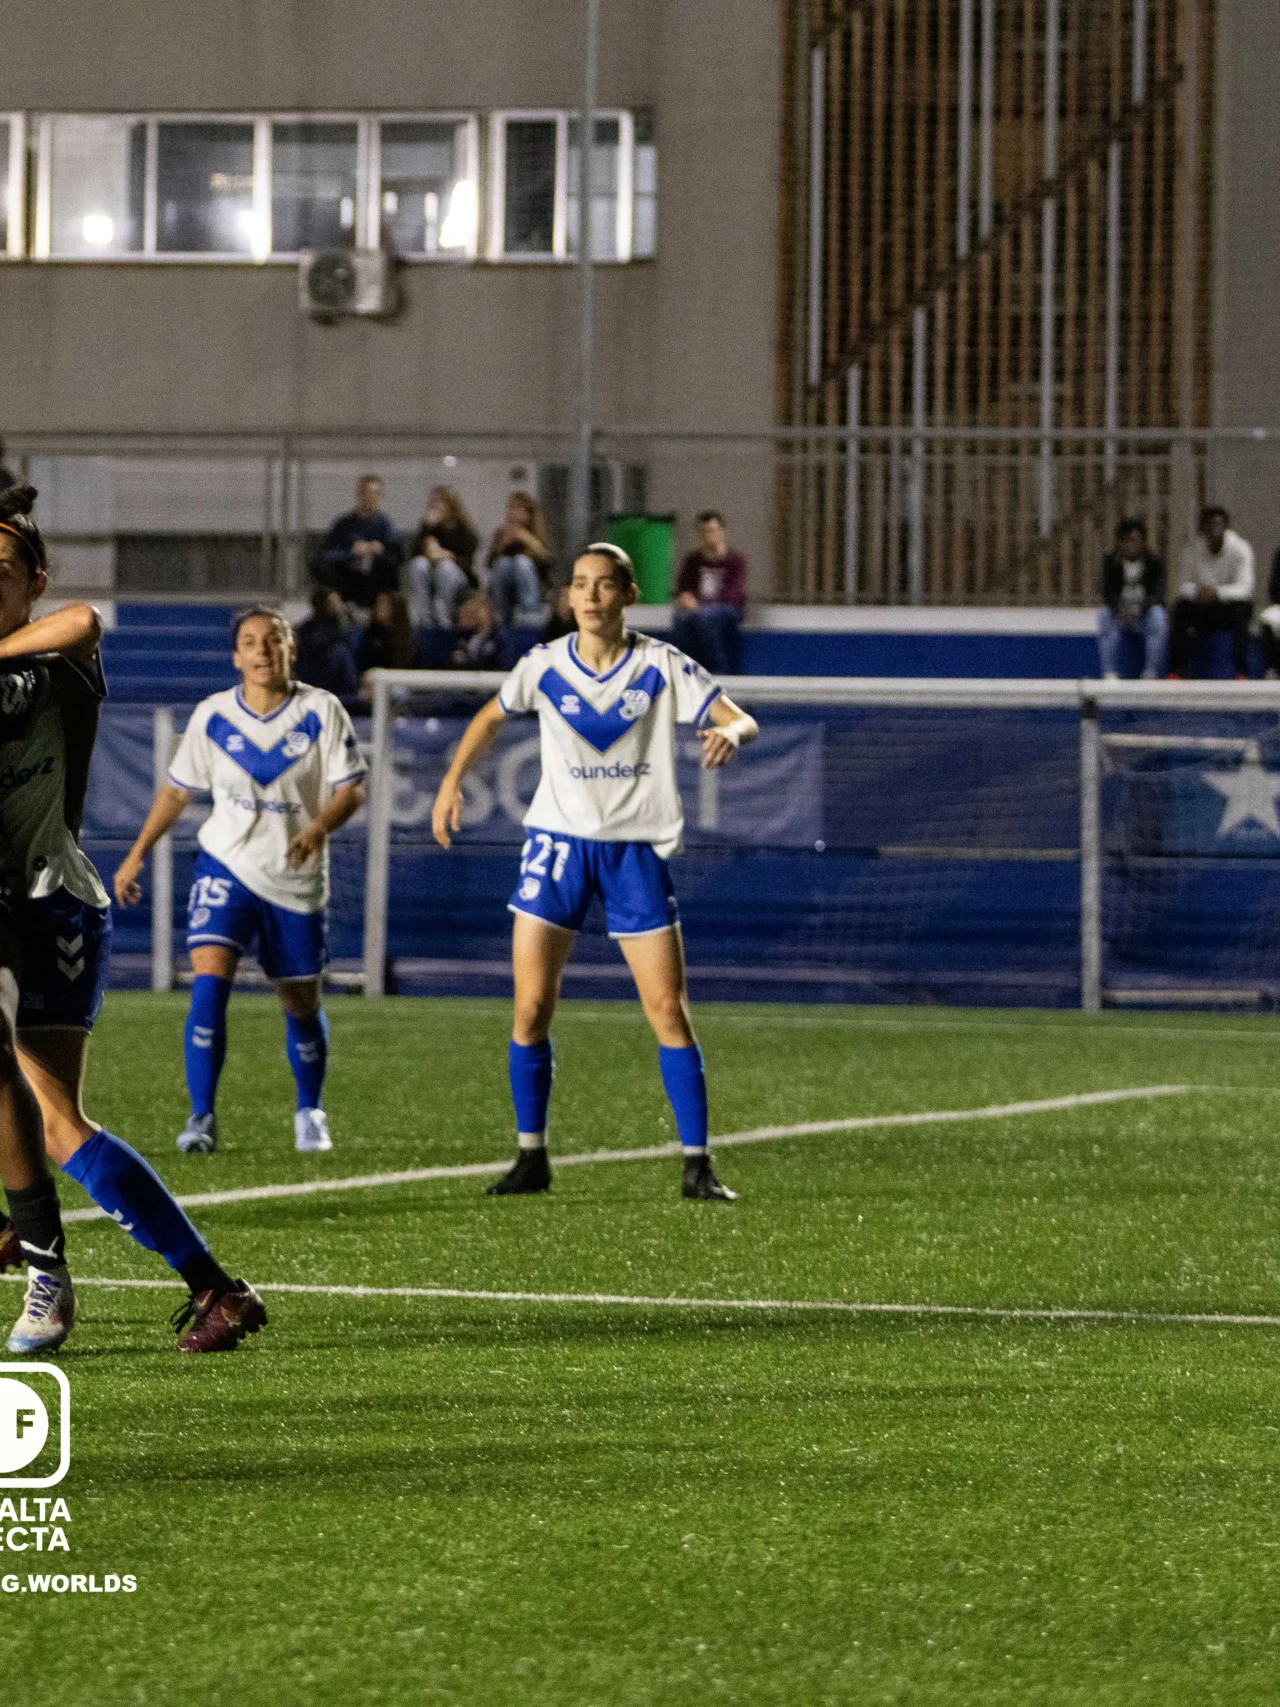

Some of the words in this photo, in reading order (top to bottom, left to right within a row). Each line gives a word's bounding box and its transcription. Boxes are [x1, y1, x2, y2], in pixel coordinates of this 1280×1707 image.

[566, 759, 651, 779] ounderz
[527, 833, 571, 882] 21
[198, 875, 232, 907] 15
